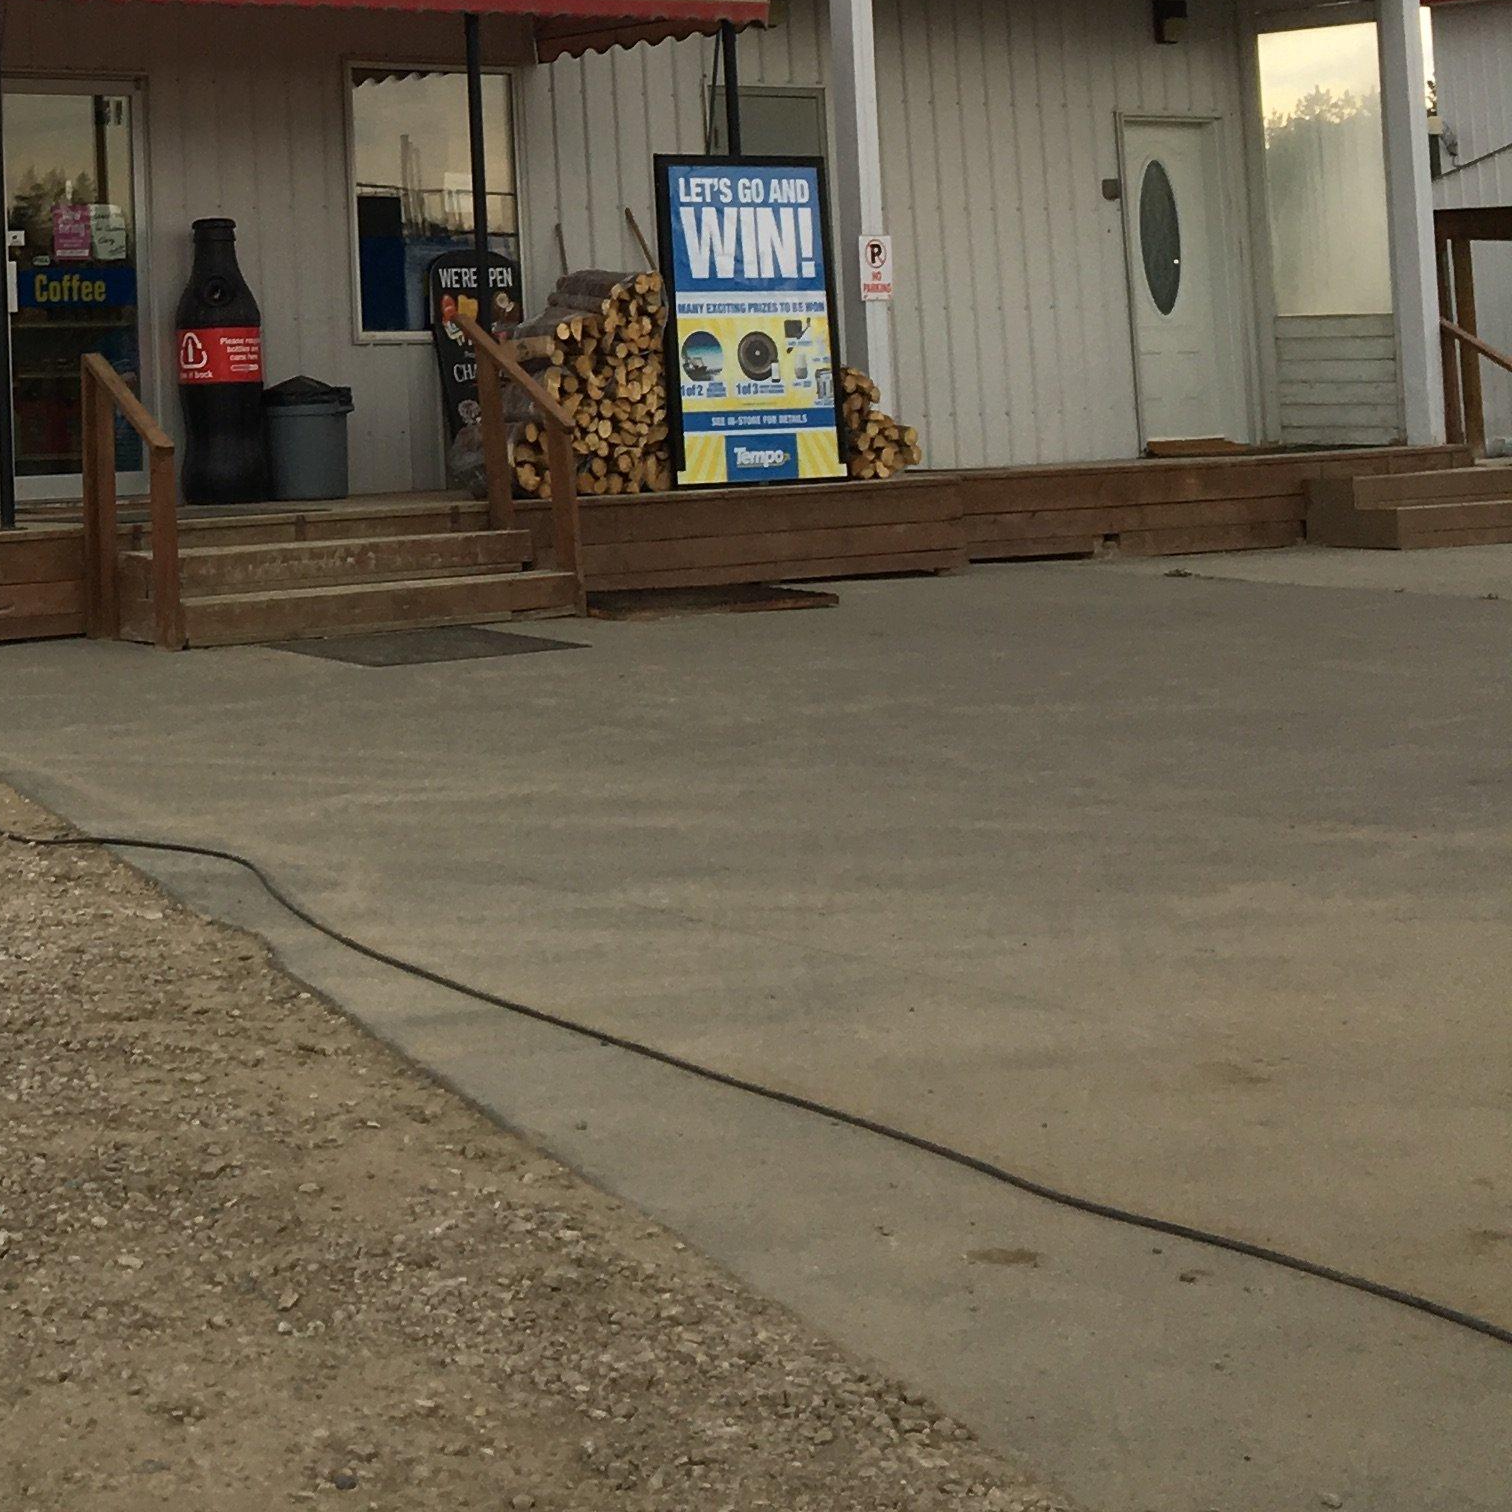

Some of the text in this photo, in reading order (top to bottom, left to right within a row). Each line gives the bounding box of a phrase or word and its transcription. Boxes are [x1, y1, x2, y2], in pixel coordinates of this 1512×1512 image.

[678, 177, 810, 204] LET'S GO AND
[679, 206, 816, 279] WIN!
[488, 267, 513, 288] PEN
[871, 270, 882, 281] NO
[34, 273, 107, 303] Coffee
[863, 283, 892, 293] PARKING
[677, 303, 705, 314] MANY
[706, 303, 746, 314] EXCITING
[748, 302, 779, 313] PRIZES
[780, 302, 791, 313] TO
[792, 302, 804, 313] BE
[220, 337, 244, 345] Please
[194, 370, 213, 379] back
[686, 384, 696, 396] of
[697, 384, 703, 396] 2
[736, 384, 741, 395] 1
[742, 383, 752, 395] of
[753, 383, 759, 395] 3
[711, 414, 808, 427] SEE IN-STORE FOR DETAILS
[733, 446, 785, 468] Tempo
